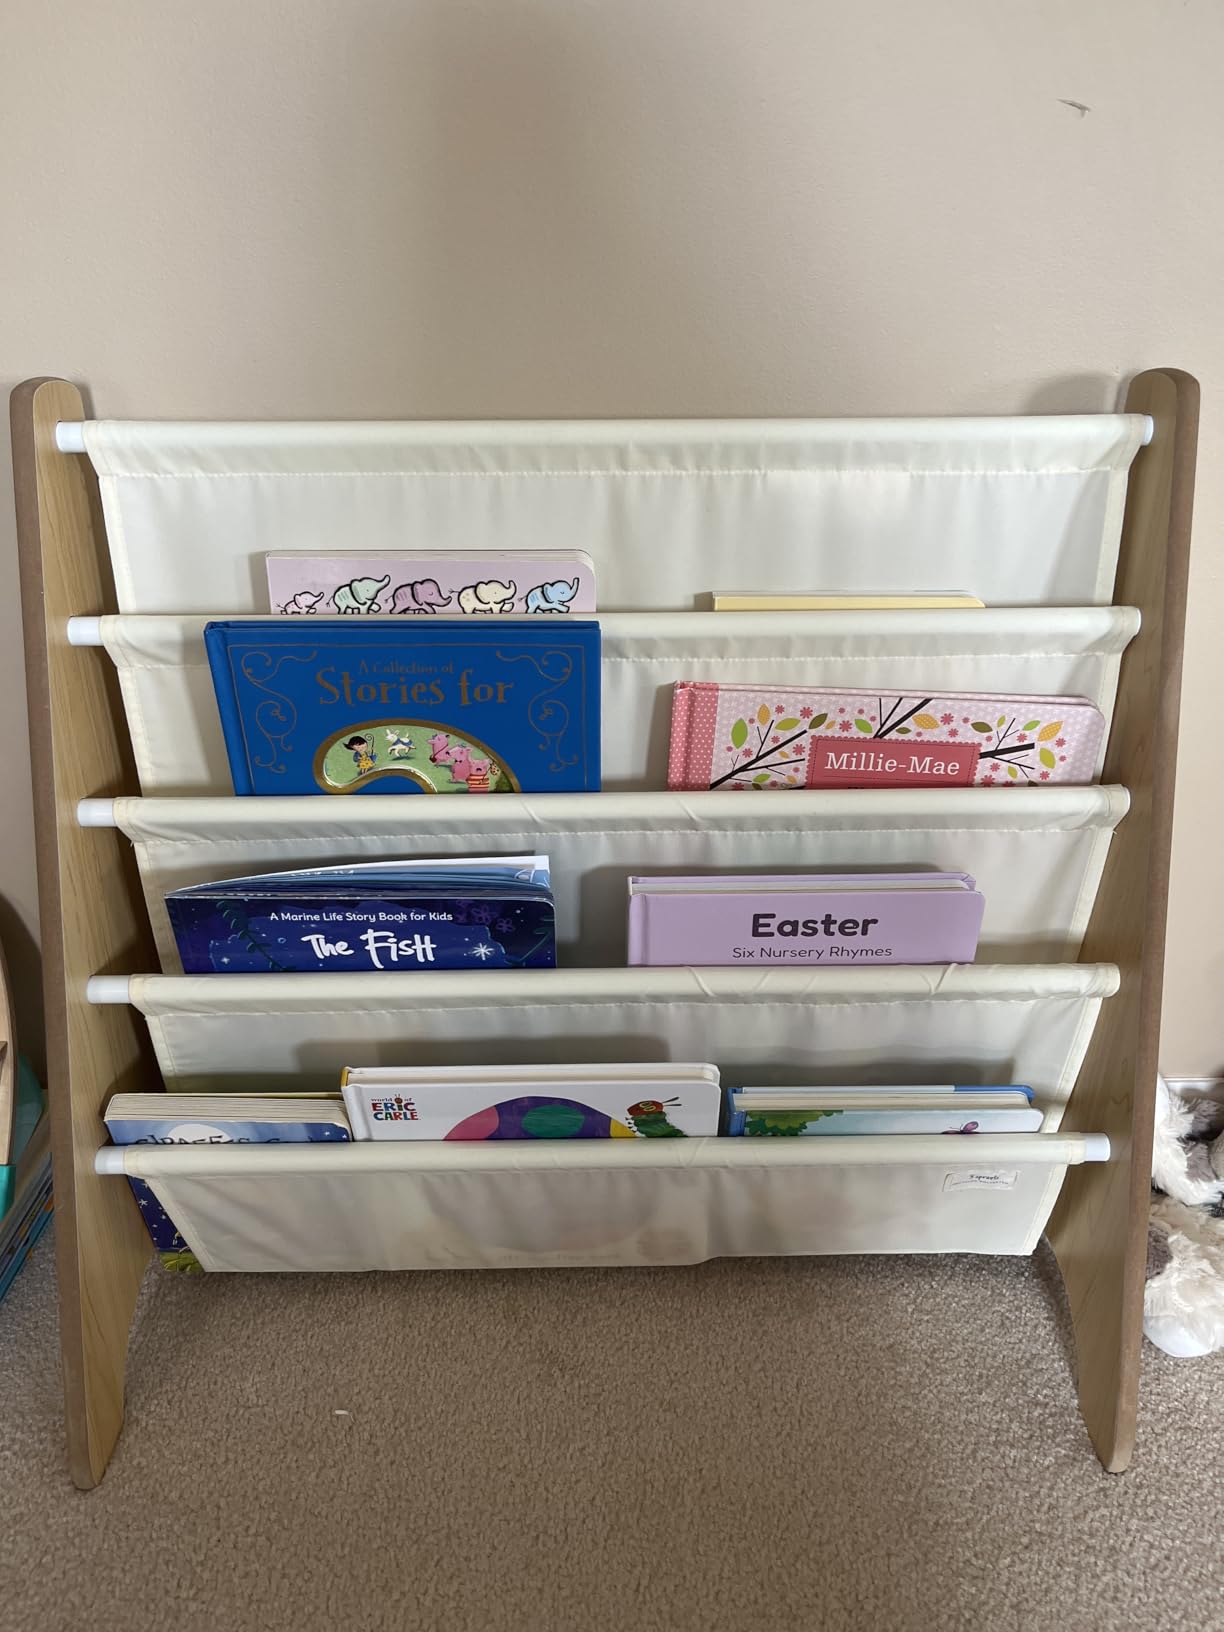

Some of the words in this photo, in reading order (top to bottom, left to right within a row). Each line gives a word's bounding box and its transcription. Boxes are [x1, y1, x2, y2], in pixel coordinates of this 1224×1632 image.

[358, 658, 370, 675] A
[373, 659, 439, 675] Collection
[440, 659, 455, 675] of
[315, 665, 446, 707] Stories
[458, 668, 515, 707] for
[824, 751, 961, 776] Millie-Mae
[269, 912, 279, 922] A
[280, 912, 321, 922] Marine
[323, 911, 345, 922] Life
[345, 912, 377, 923] Story
[378, 912, 408, 923] Book
[409, 911, 427, 922] for
[428, 911, 454, 922] Kids
[751, 912, 880, 938] Easter
[300, 933, 355, 960] The
[732, 947, 756, 959] Six
[759, 947, 826, 960] Nursery
[828, 945, 893, 960] Rhymes
[372, 1111, 419, 1121] CARLE
